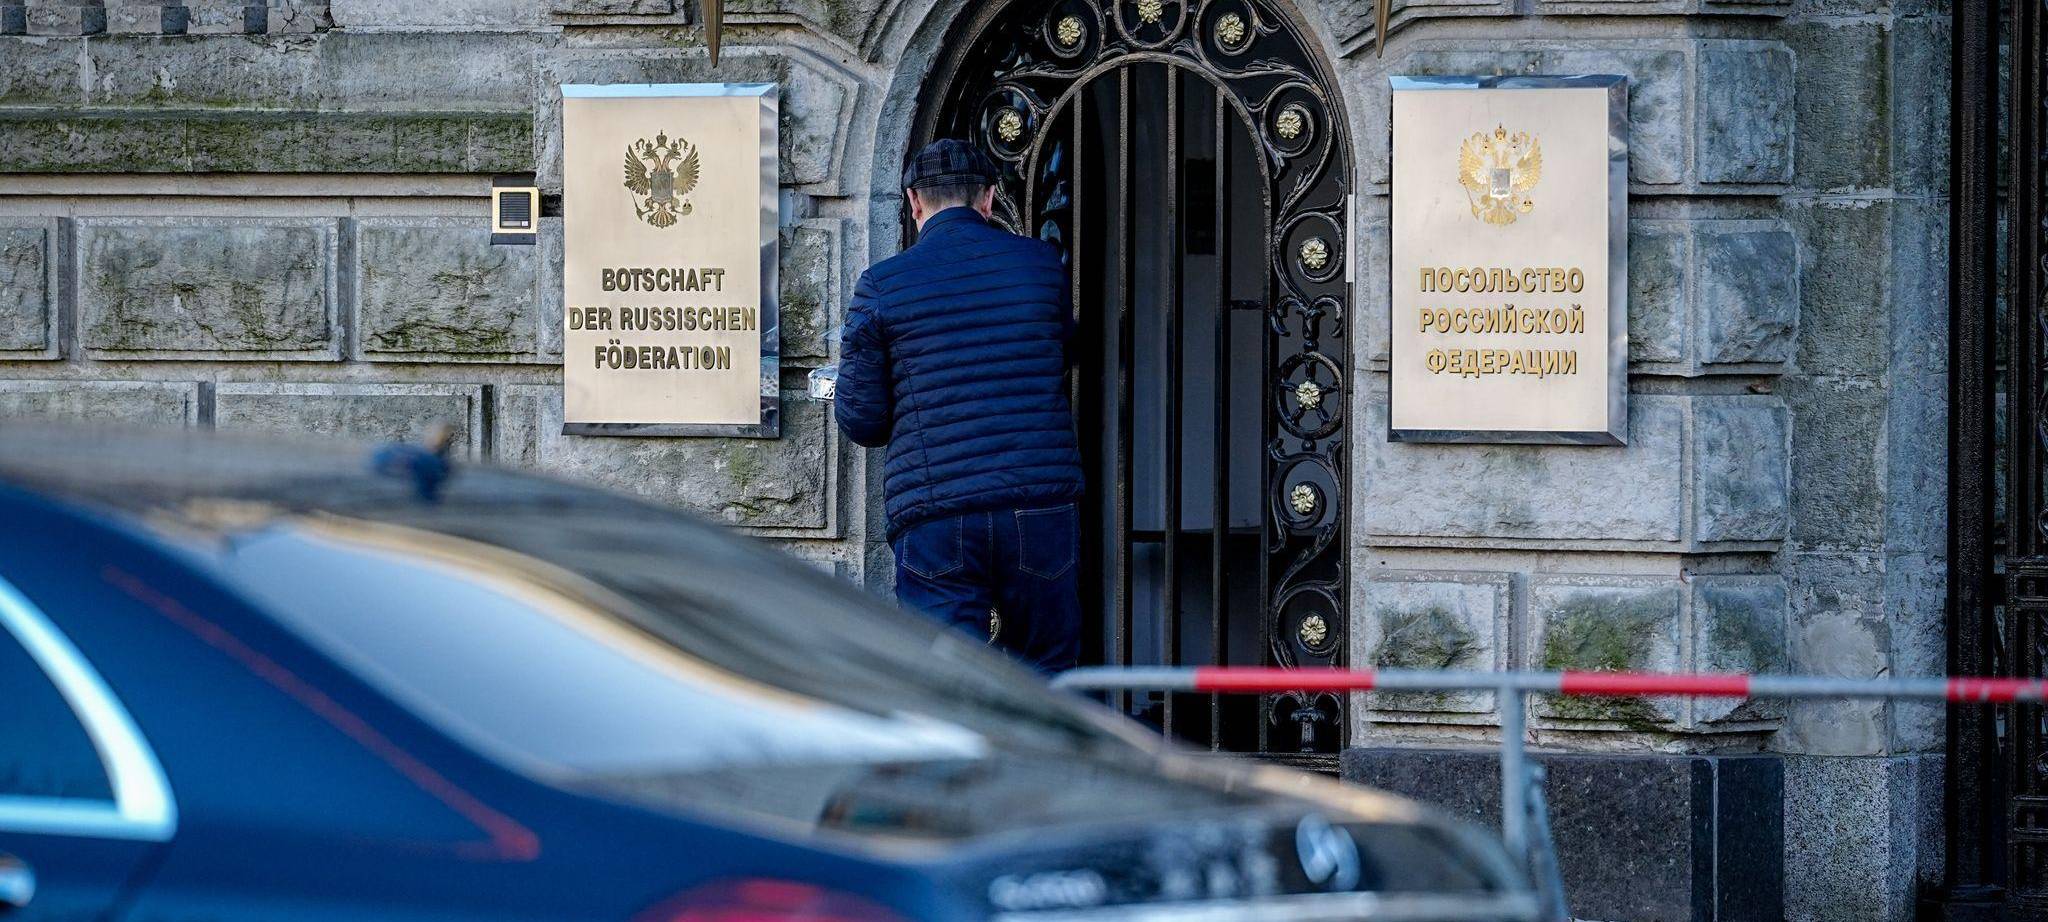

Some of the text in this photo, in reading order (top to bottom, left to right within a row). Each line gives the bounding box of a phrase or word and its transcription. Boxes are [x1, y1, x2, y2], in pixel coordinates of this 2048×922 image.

[602, 267, 725, 292] BOTSCHAFT
[1419, 267, 1585, 293] ПОСОЛЬСТВО
[569, 306, 756, 331] DER RUSSISCHEN
[1419, 303, 1584, 333] РОССИЙСКОЙ
[594, 338, 731, 370] FÖDERATION
[1425, 348, 1577, 379] ФЕДЕРАЦИИ
